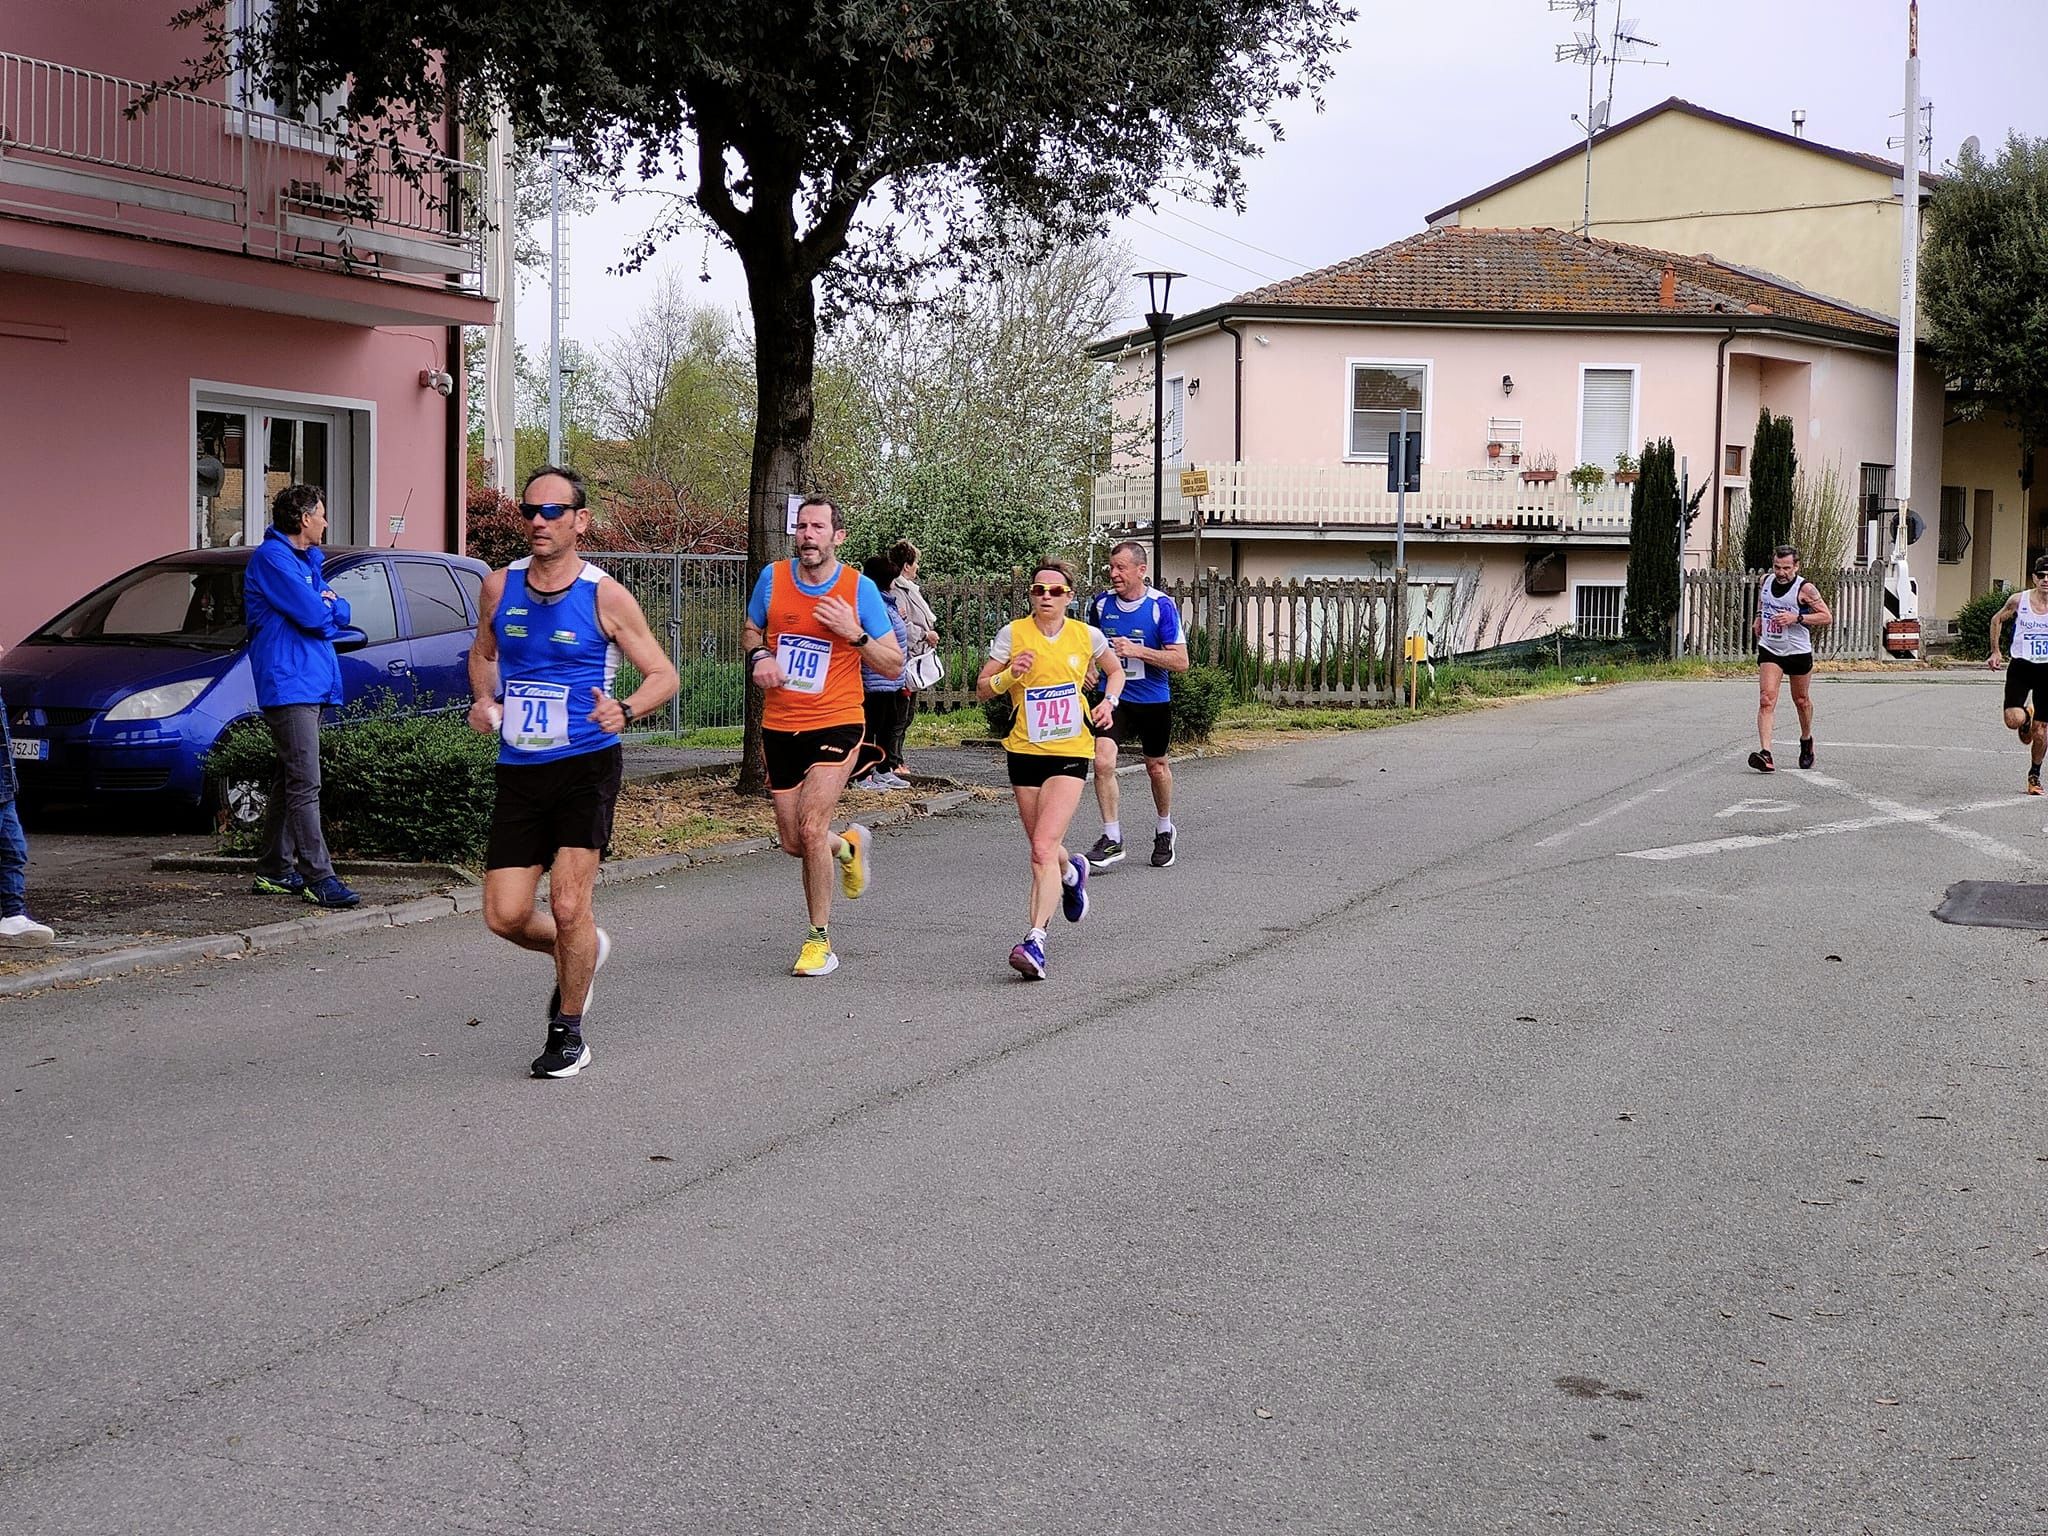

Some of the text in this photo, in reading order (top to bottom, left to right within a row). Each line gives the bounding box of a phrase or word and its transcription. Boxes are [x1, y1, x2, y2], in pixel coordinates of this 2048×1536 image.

[787, 649, 819, 679] 149
[522, 699, 549, 733] 24
[1036, 698, 1072, 728] 242
